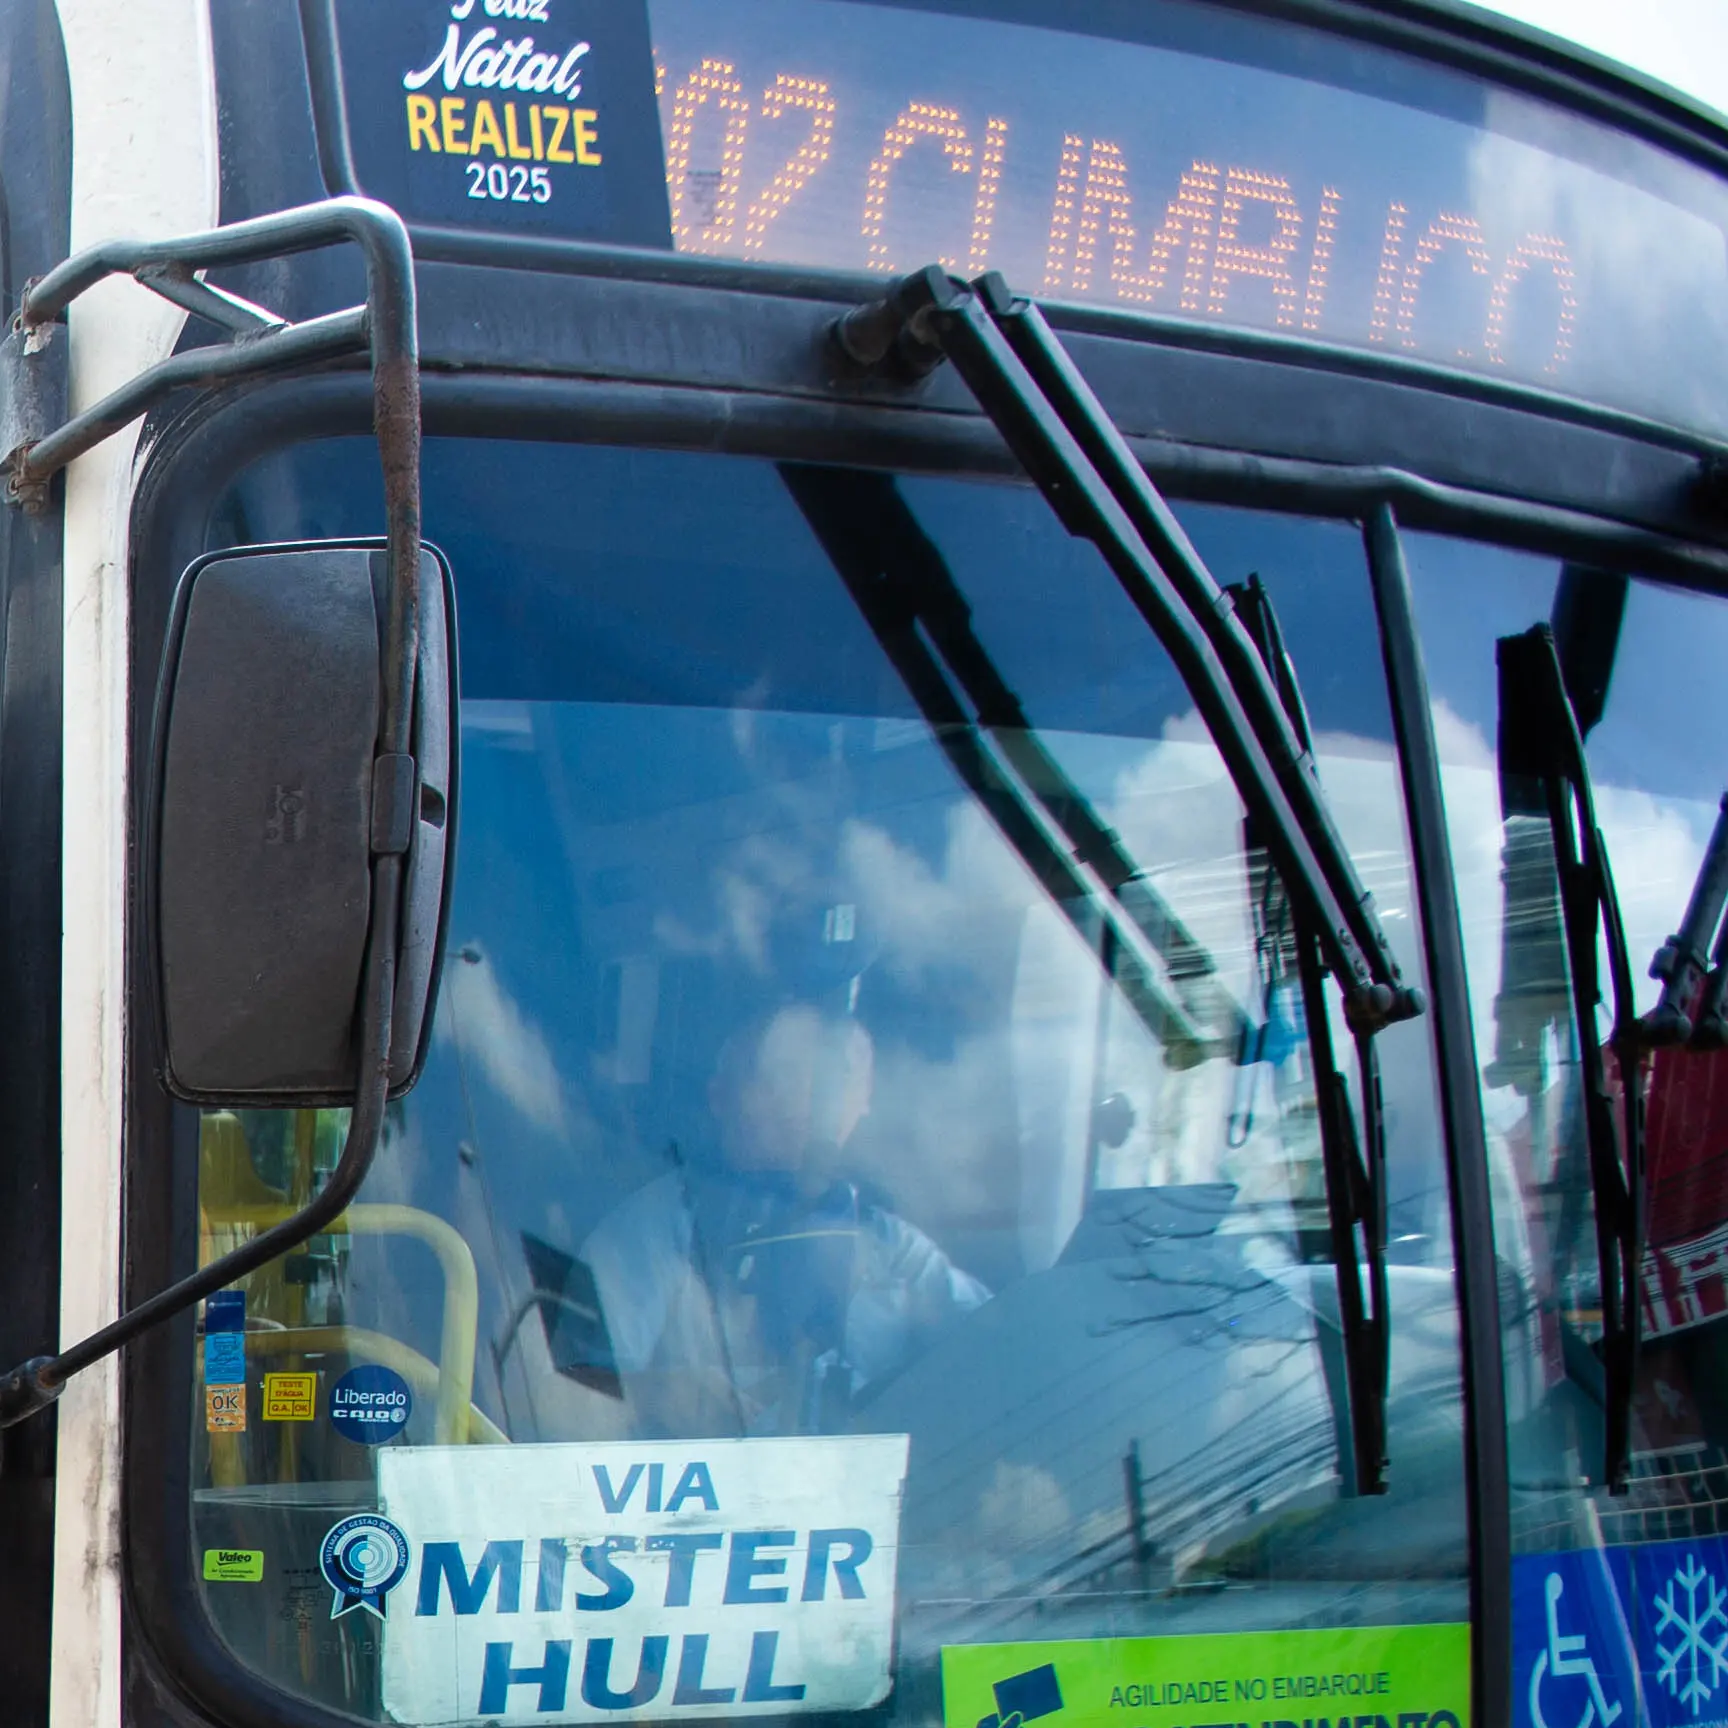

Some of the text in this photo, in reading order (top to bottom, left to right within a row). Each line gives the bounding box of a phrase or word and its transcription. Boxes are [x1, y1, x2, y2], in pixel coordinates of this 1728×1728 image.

[402, 22, 592, 101] Natal,
[406, 94, 602, 166] REALIZE
[652, 45, 838, 258] 02
[464, 161, 553, 203] 2025
[332, 1409, 390, 1419] CAIO
[335, 1388, 406, 1406] Liberado
[591, 1461, 720, 1514] VIA
[218, 1551, 252, 1562] Valeo
[414, 1527, 874, 1617] MISTER
[477, 1630, 807, 1716] HULL
[1108, 1671, 1391, 1709] AGILIDADE NO EMBARQUE
